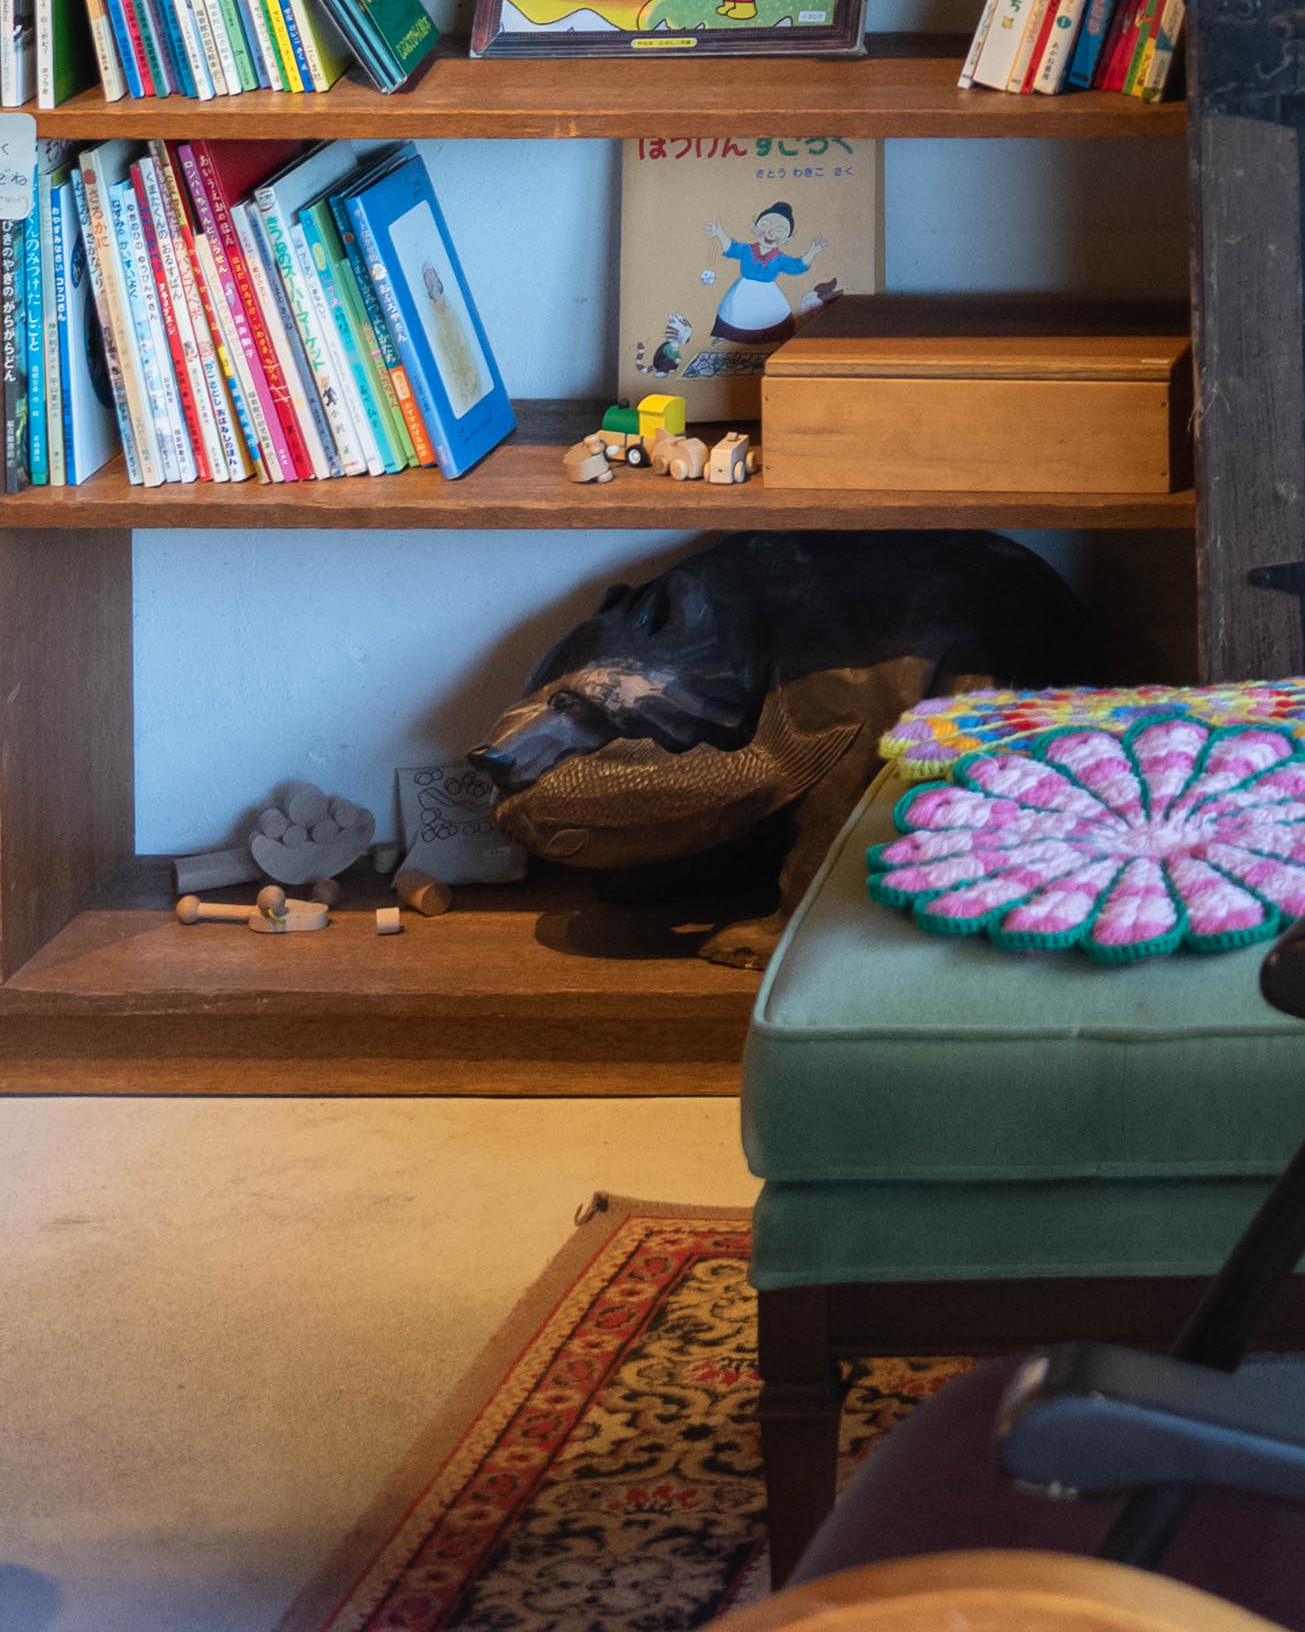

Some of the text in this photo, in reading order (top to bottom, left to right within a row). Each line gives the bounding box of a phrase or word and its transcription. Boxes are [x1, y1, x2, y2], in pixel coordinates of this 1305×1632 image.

[793, 167, 825, 177] わきこ
[86, 188, 110, 248] さるかに
[146, 173, 167, 238] くまたくんの
[55, 277, 67, 321] コッコさん
[137, 255, 157, 321] ゆうびんやさん
[3, 303, 16, 382] がらがらどん
[27, 315, 40, 352] しごと
[204, 361, 239, 467] かこさとし おはなしのほん
